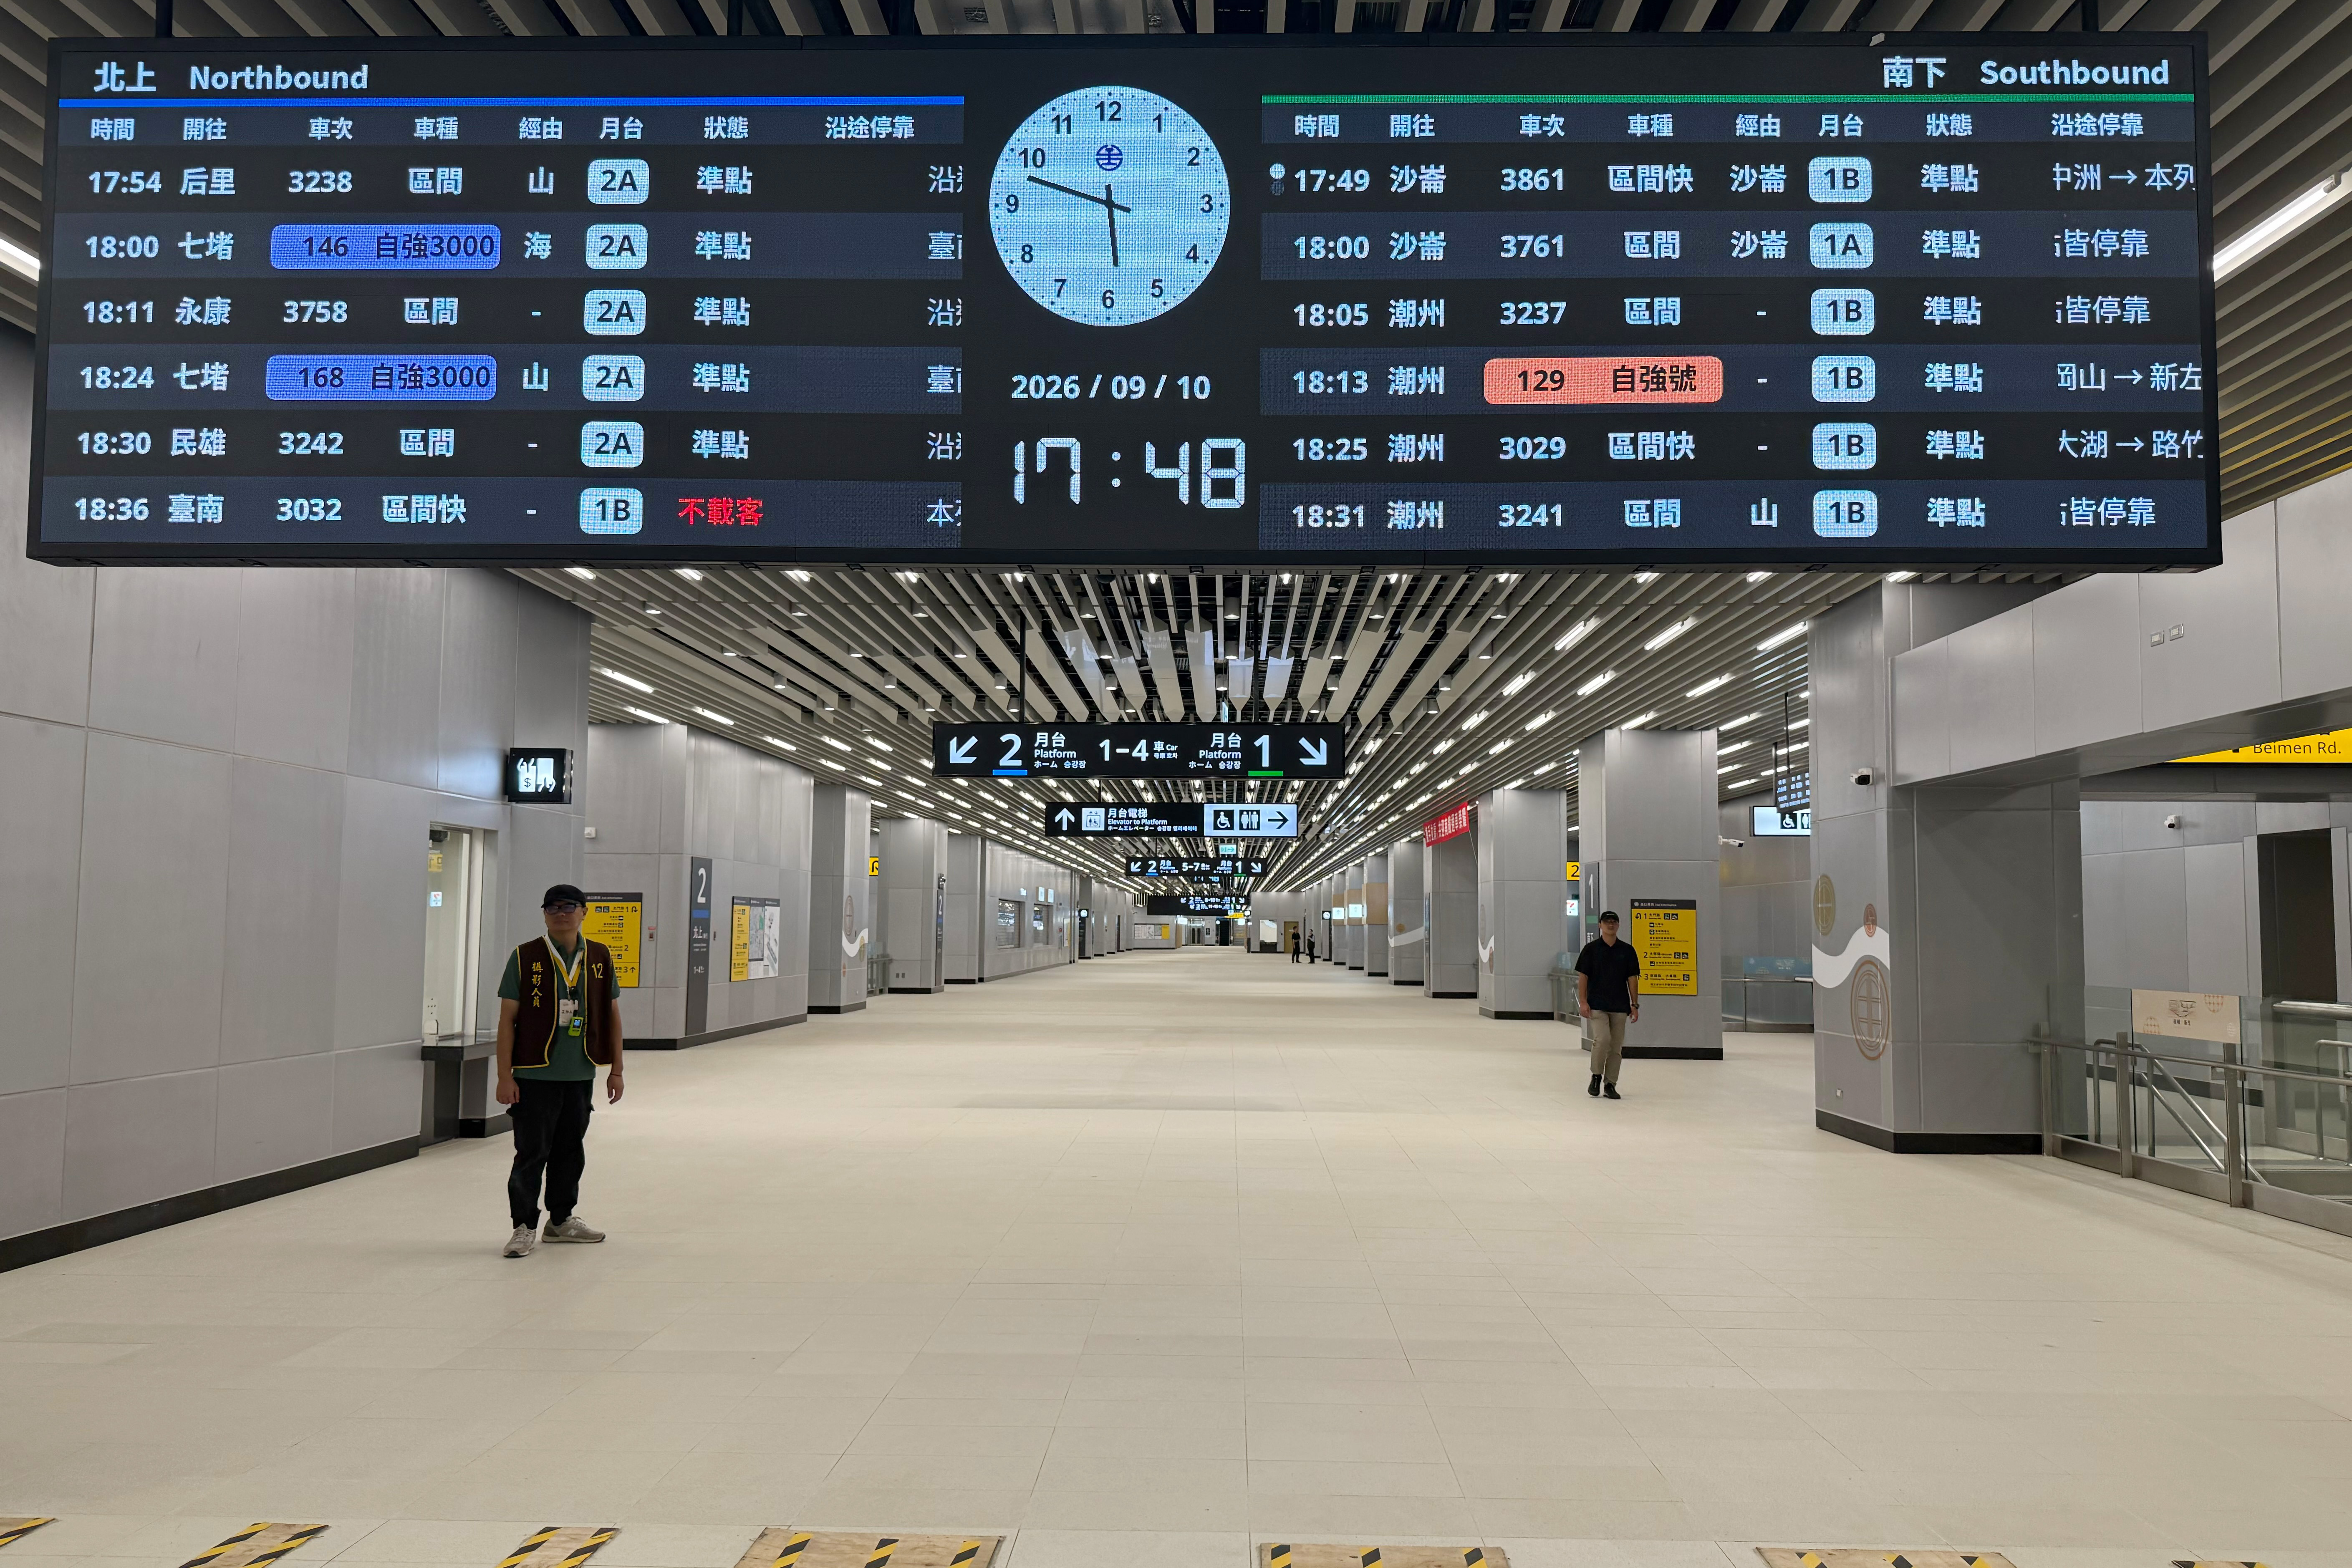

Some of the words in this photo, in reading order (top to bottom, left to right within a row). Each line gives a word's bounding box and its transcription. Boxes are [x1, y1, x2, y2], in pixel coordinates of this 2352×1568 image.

[94, 62, 156, 92] 北上
[191, 65, 368, 90] Northbound
[1883, 56, 1947, 88] 南下
[1981, 60, 2169, 85] Southbound
[1095, 101, 1121, 121] 12
[91, 118, 135, 141] 時間
[184, 118, 227, 141] 開往
[310, 118, 353, 140] 車次
[414, 117, 459, 140] 車種
[520, 117, 563, 140] 經由
[600, 117, 644, 139] 月台
[704, 117, 749, 139] 狀態
[826, 116, 915, 139] 沿途停靠
[1051, 114, 1073, 134] 11
[1153, 113, 1163, 133] 1
[1296, 115, 1340, 138] 時間
[1391, 114, 1435, 138] 開往
[1520, 114, 1565, 137] 車次
[1628, 114, 1674, 137] 車種
[1736, 114, 1780, 137] 經由
[1819, 114, 1864, 137] 月台
[1927, 114, 1972, 137] 狀態
[2052, 113, 2144, 136] 沿途停靠
[1019, 148, 1045, 169] 10
[1187, 148, 1200, 166] 2
[89, 172, 162, 194] 17:54
[181, 168, 235, 195] 后里
[289, 171, 352, 193] 3238
[409, 168, 462, 195] 區間
[529, 167, 554, 195] 山
[601, 170, 638, 192] 2A
[697, 166, 753, 194] 準點
[1295, 169, 1370, 192] 17:49
[1390, 165, 1446, 194] 沙崙
[1502, 169, 1563, 191] 3861
[1608, 164, 1693, 193] 區間快
[1731, 165, 1787, 193] 沙崙
[1824, 168, 1860, 190] 1B
[1922, 164, 1979, 193] 準點
[1006, 194, 1019, 214] 9
[1200, 194, 1213, 213] 3
[86, 236, 159, 258] 18:00
[179, 232, 234, 260] 七堵
[304, 236, 348, 257] 146
[376, 232, 495, 259] 自強3000
[525, 232, 552, 259] 海
[599, 235, 636, 257] 2A
[696, 232, 752, 260] 準點
[1021, 245, 1033, 263] 8
[1186, 245, 1199, 263] 4
[1295, 237, 1370, 259] 18:00
[1390, 232, 1447, 261] 沙崙
[1502, 235, 1563, 258] 3761
[1624, 232, 1680, 259] 區間
[1731, 231, 1788, 259] 沙崙
[1825, 234, 1862, 256] 1A
[1923, 230, 1980, 259] 準點
[1054, 279, 1067, 297] 7
[1151, 280, 1164, 298] 5
[1102, 290, 1115, 308] 6
[84, 302, 153, 323] 18:11
[176, 297, 231, 325] 永康
[284, 302, 348, 323] 3758
[405, 298, 458, 325] 區間
[597, 300, 635, 322] 2A
[694, 297, 750, 326] 準點
[1295, 304, 1368, 326] 18:05
[1389, 300, 1444, 328] 潮州
[1501, 303, 1567, 325] 3237
[1625, 298, 1681, 326] 區間
[1827, 300, 1862, 322] 1B
[1924, 297, 1981, 325] 準點
[81, 367, 154, 389] 18:24
[174, 362, 230, 391] 七堵
[299, 367, 343, 388] 168
[372, 363, 490, 390] 自強3000
[523, 363, 549, 391] 山
[596, 366, 633, 388] 2A
[694, 363, 750, 393] 準點
[1012, 375, 1080, 399] 2026
[1294, 371, 1368, 394] 18:13
[1389, 366, 1444, 396] 潮州
[1518, 369, 1565, 391] 129
[1613, 364, 1697, 393] 自強號
[1828, 367, 1863, 389] 1B
[1926, 363, 1983, 393] 準點
[78, 433, 151, 454] 18:30
[172, 428, 226, 456] 民雄
[280, 433, 343, 454] 3242
[400, 430, 454, 457] 區間
[594, 432, 632, 455] 2A
[693, 430, 749, 459] 準點
[1294, 439, 1368, 461] 18:25
[1388, 434, 1444, 463] 潮州
[1500, 437, 1566, 459] 3029
[1608, 431, 1695, 461] 區間快
[1829, 434, 1864, 456] 1B
[1927, 431, 1984, 460] 準點
[1015, 438, 1245, 508] 17:48
[76, 499, 149, 521] 18:36
[169, 494, 224, 523] 臺南
[278, 499, 342, 521] 3032
[383, 495, 466, 524] 區間快
[596, 499, 630, 521] 1B
[679, 498, 763, 526] 不載客
[1293, 506, 1364, 528] 18:31
[1388, 501, 1443, 530] 潮州
[1500, 505, 1562, 527] 3241
[1624, 499, 1681, 528] 區間
[1752, 498, 1778, 527] 山
[1829, 502, 1865, 524] 1B
[1928, 498, 1986, 527] 準點
[999, 734, 1022, 766] 2
[1034, 732, 1066, 747] 月台
[1153, 741, 1165, 752] 車
[1211, 733, 1242, 748] 月台
[2254, 743, 2312, 754] Beimen
[2318, 741, 2342, 754] Rd.
[1034, 749, 1076, 758] Platform
[1199, 750, 1242, 759] Platform
[1254, 735, 1269, 767] 1
[1064, 760, 1086, 769] 승강장
[1219, 761, 1242, 769] 승강장
[1108, 808, 1148, 818] 月台電梯
[1148, 861, 1156, 872] 2
[1235, 861, 1242, 873] 1
[1571, 865, 1579, 877] 2
[697, 867, 706, 903] 2
[1589, 874, 1593, 909] 1
[591, 963, 603, 979] 12
